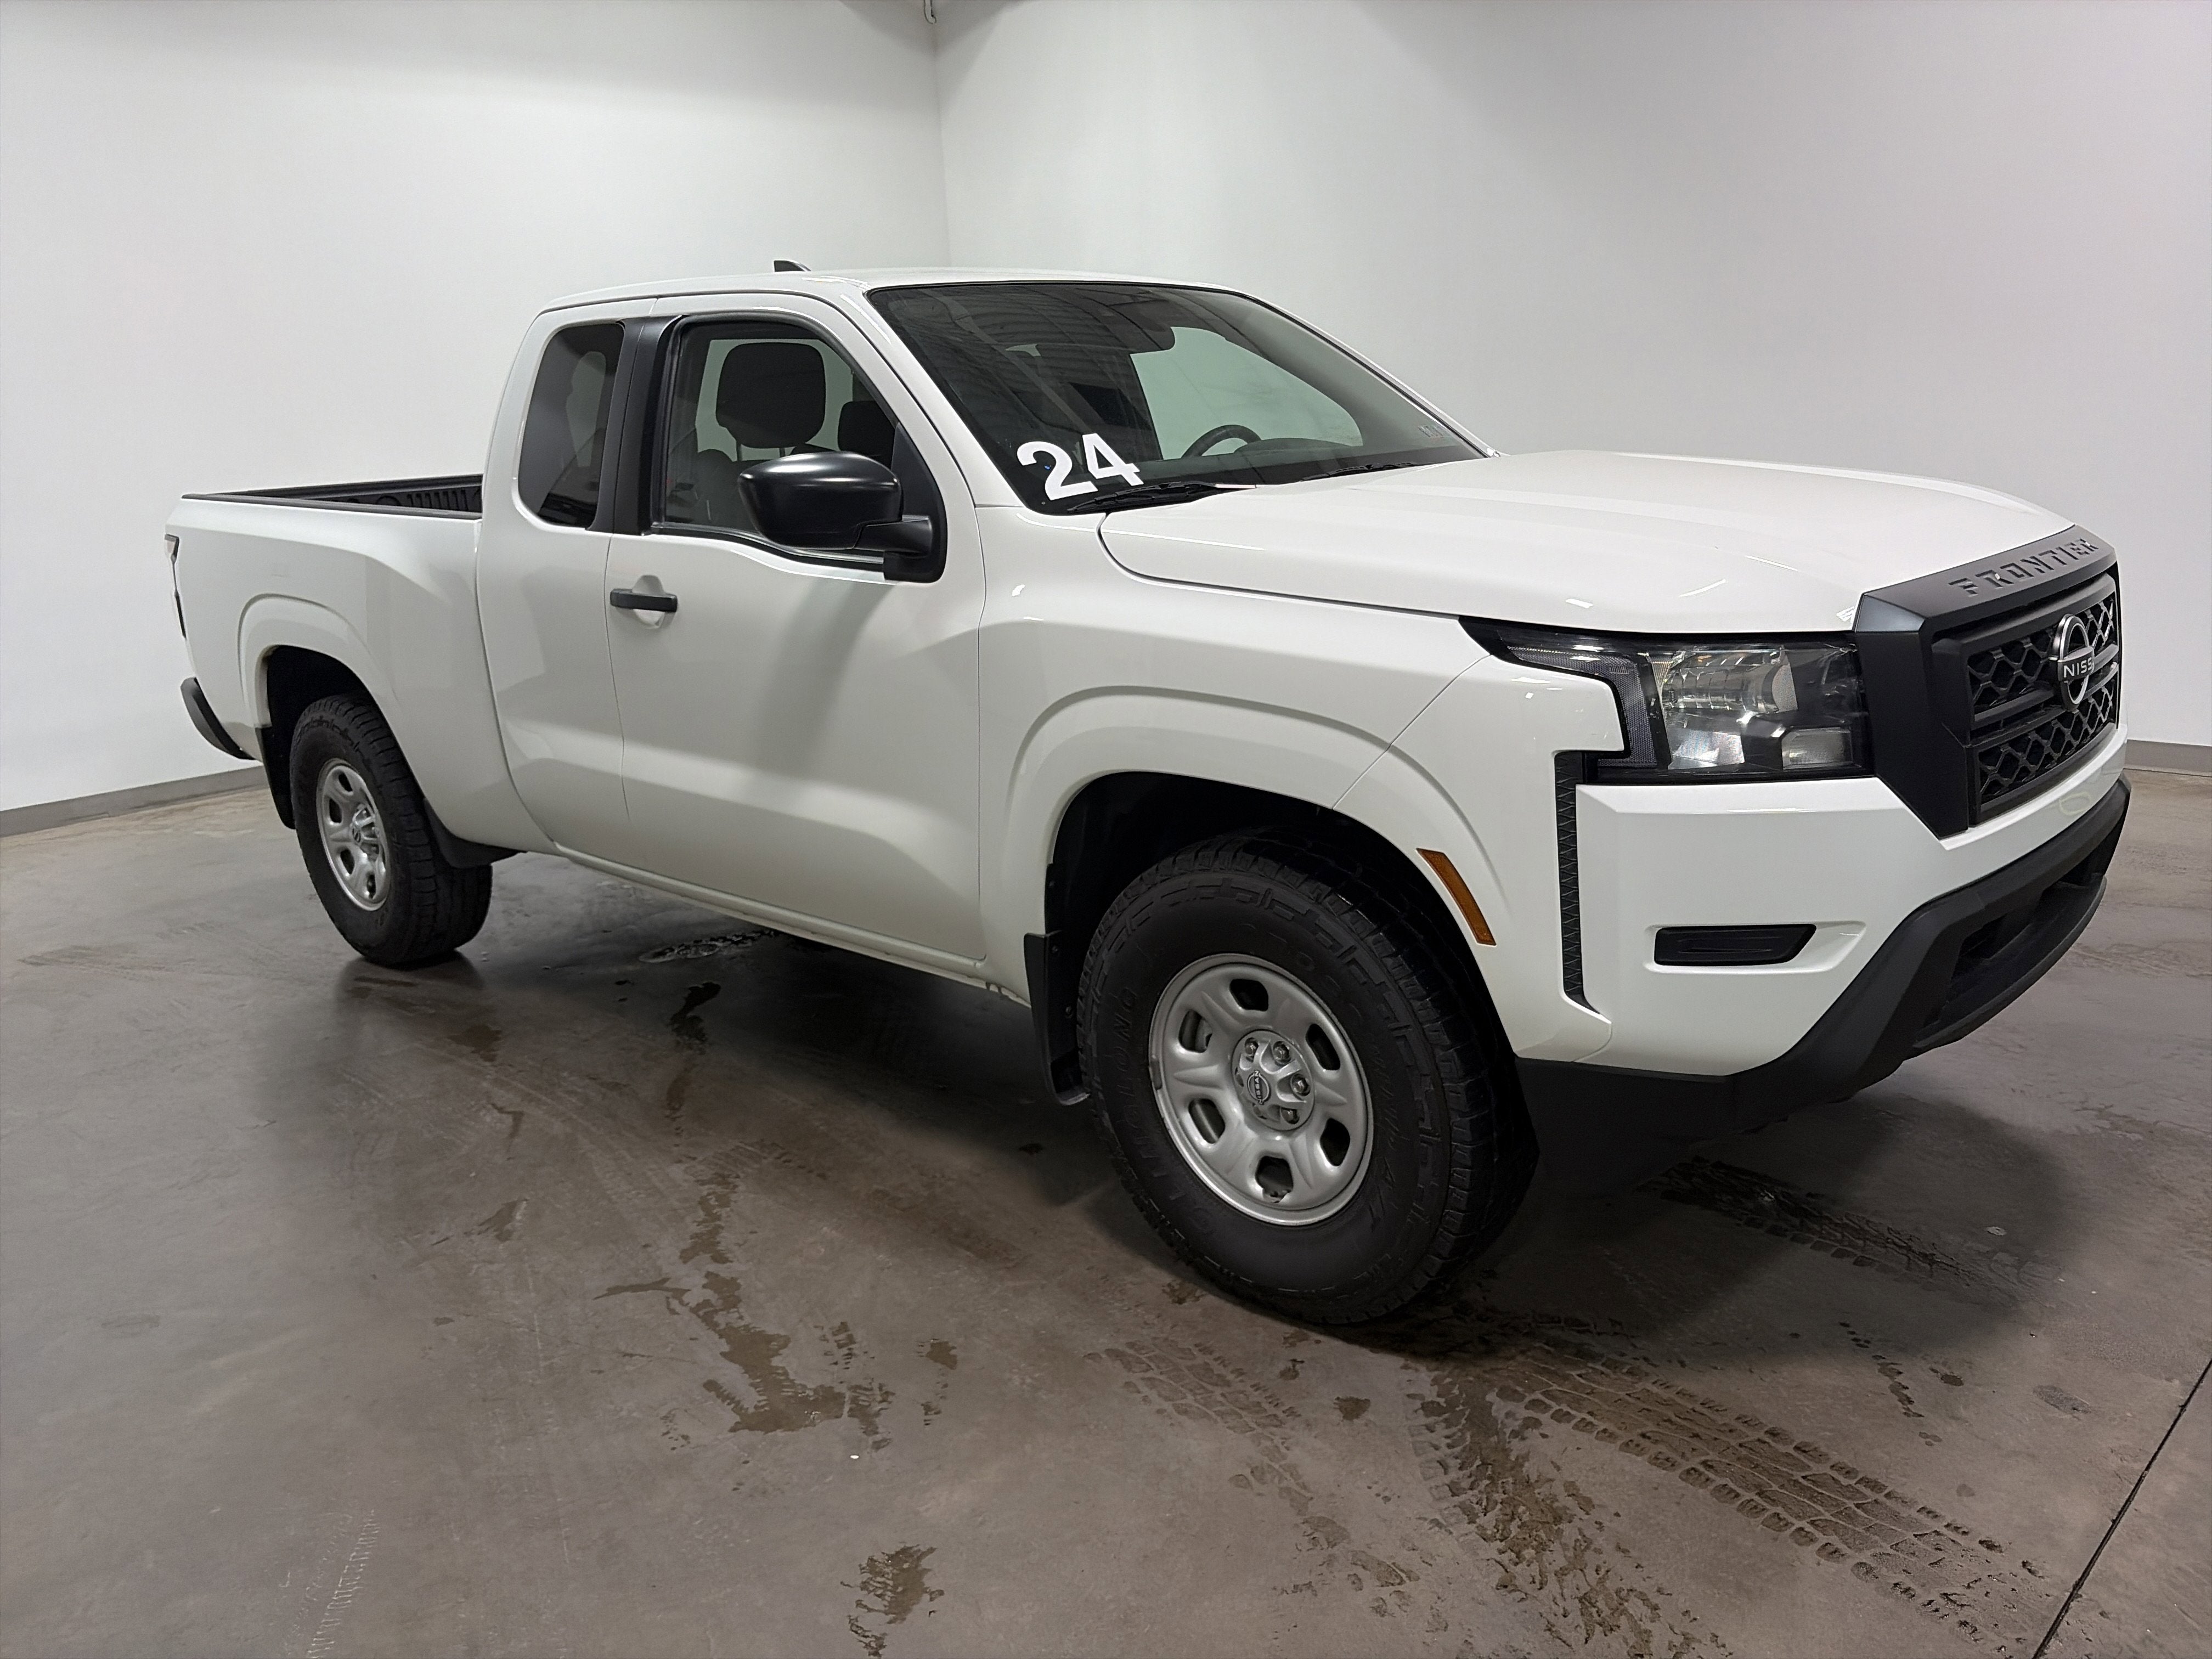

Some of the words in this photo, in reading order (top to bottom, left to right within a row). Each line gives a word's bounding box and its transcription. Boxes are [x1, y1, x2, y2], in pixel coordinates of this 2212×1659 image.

[1017, 433, 1144, 500] 24
[1948, 538, 2100, 596] FRONTIER
[2063, 657, 2092, 678] NISS
